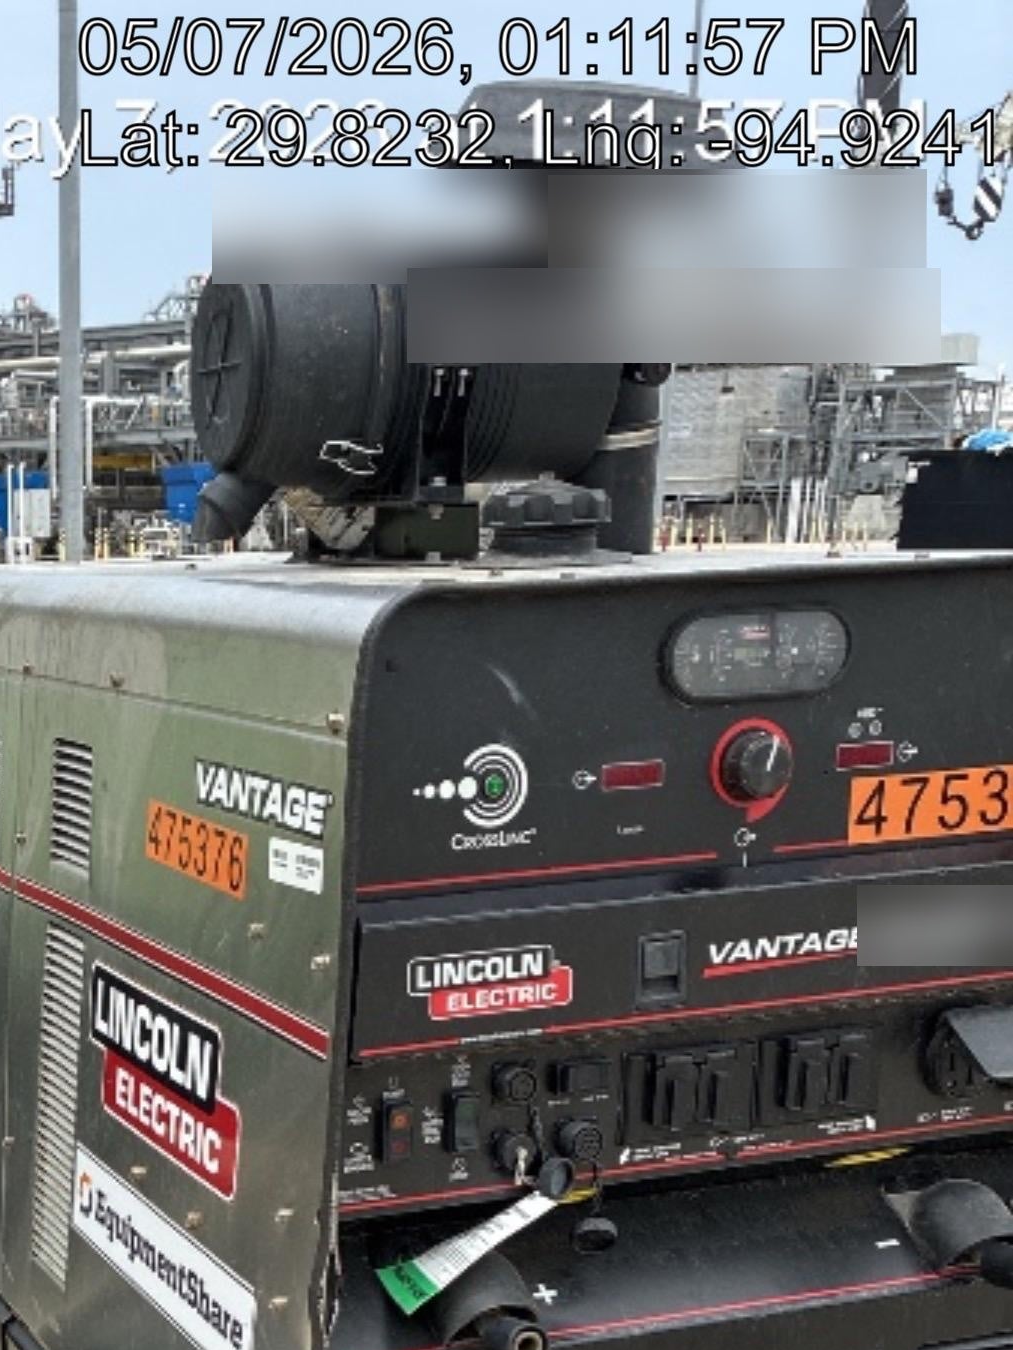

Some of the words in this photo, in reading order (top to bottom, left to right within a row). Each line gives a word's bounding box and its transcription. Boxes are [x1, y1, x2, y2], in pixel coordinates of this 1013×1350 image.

[195, 760, 328, 836] VANTAGE
[854, 768, 1009, 837] 4753
[148, 806, 244, 892] 475376
[415, 951, 545, 989] LINCOLN
[446, 982, 558, 1013] ELECTRIC
[94, 977, 213, 1101] LINCOLN
[115, 1066, 222, 1174] ELECTRIC
